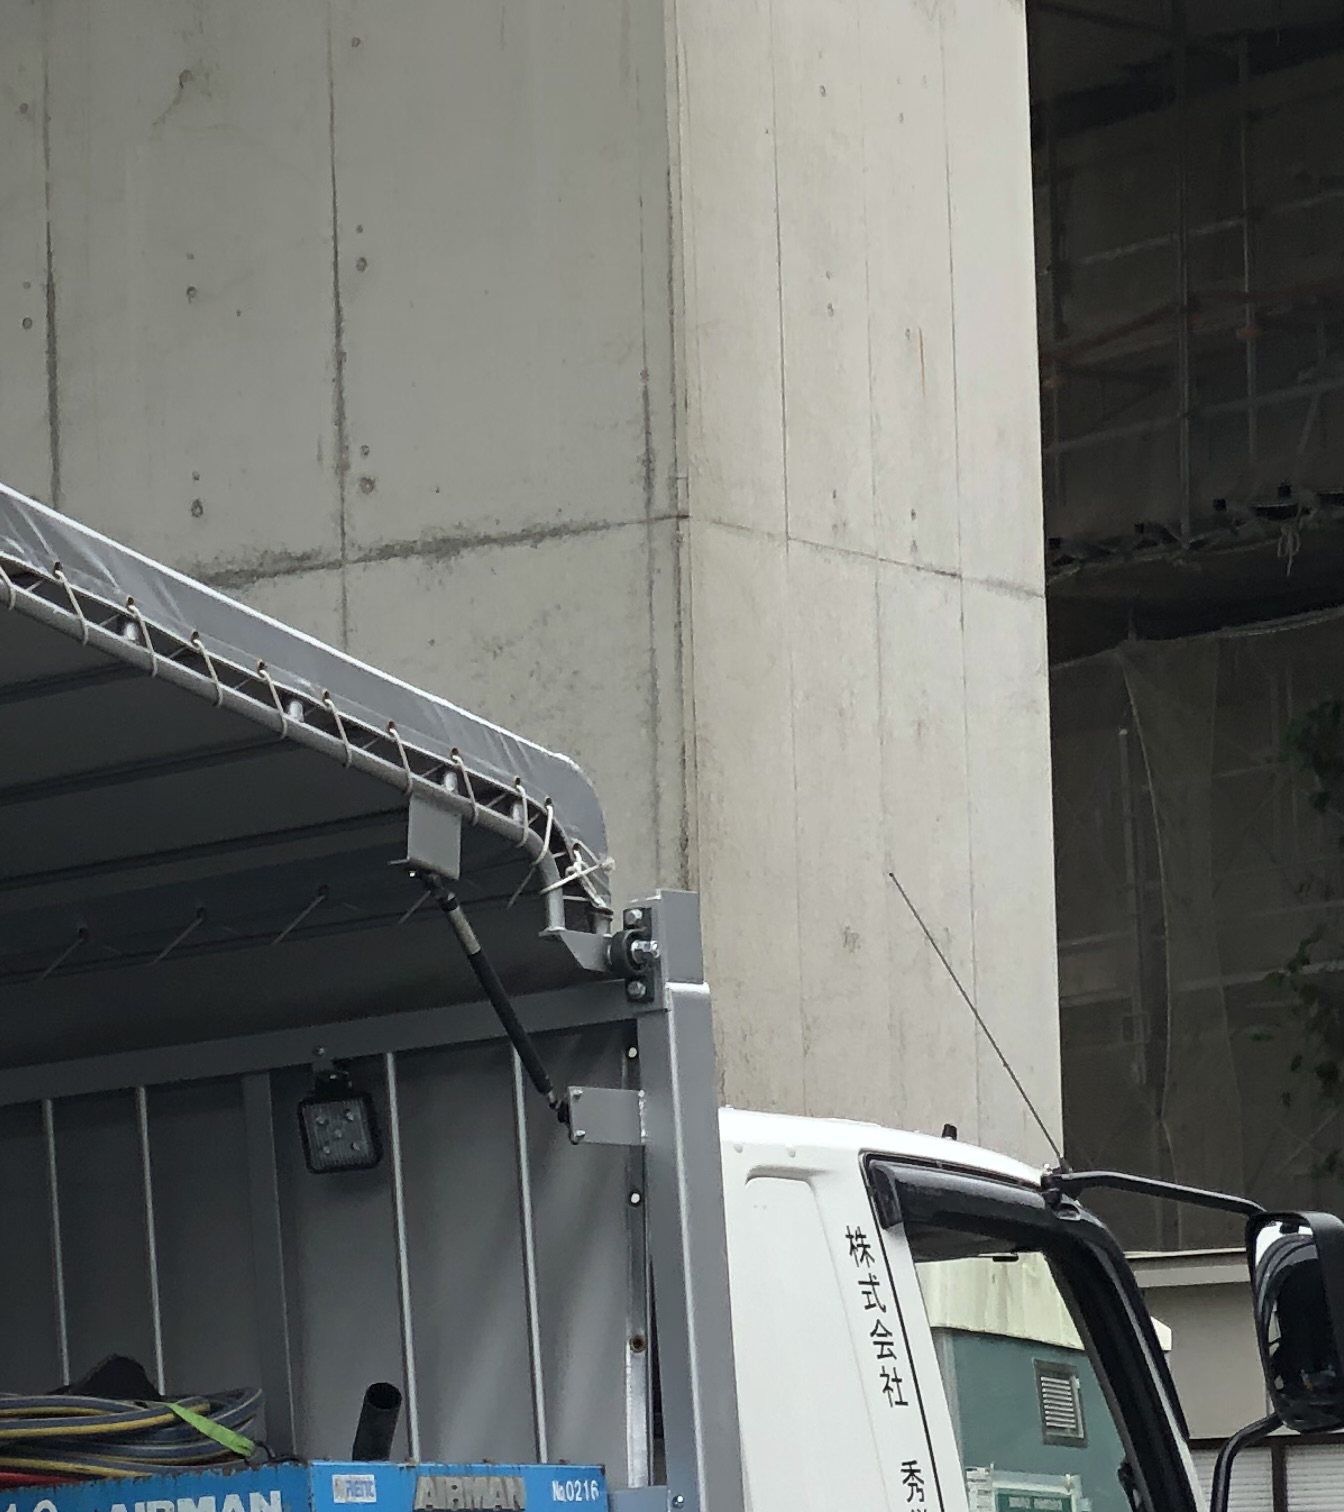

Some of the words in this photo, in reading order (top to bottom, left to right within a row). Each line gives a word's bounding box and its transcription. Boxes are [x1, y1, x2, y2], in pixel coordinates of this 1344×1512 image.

[845, 1225, 909, 1408] 株式会社
[414, 1476, 526, 1512] AIRMAN
